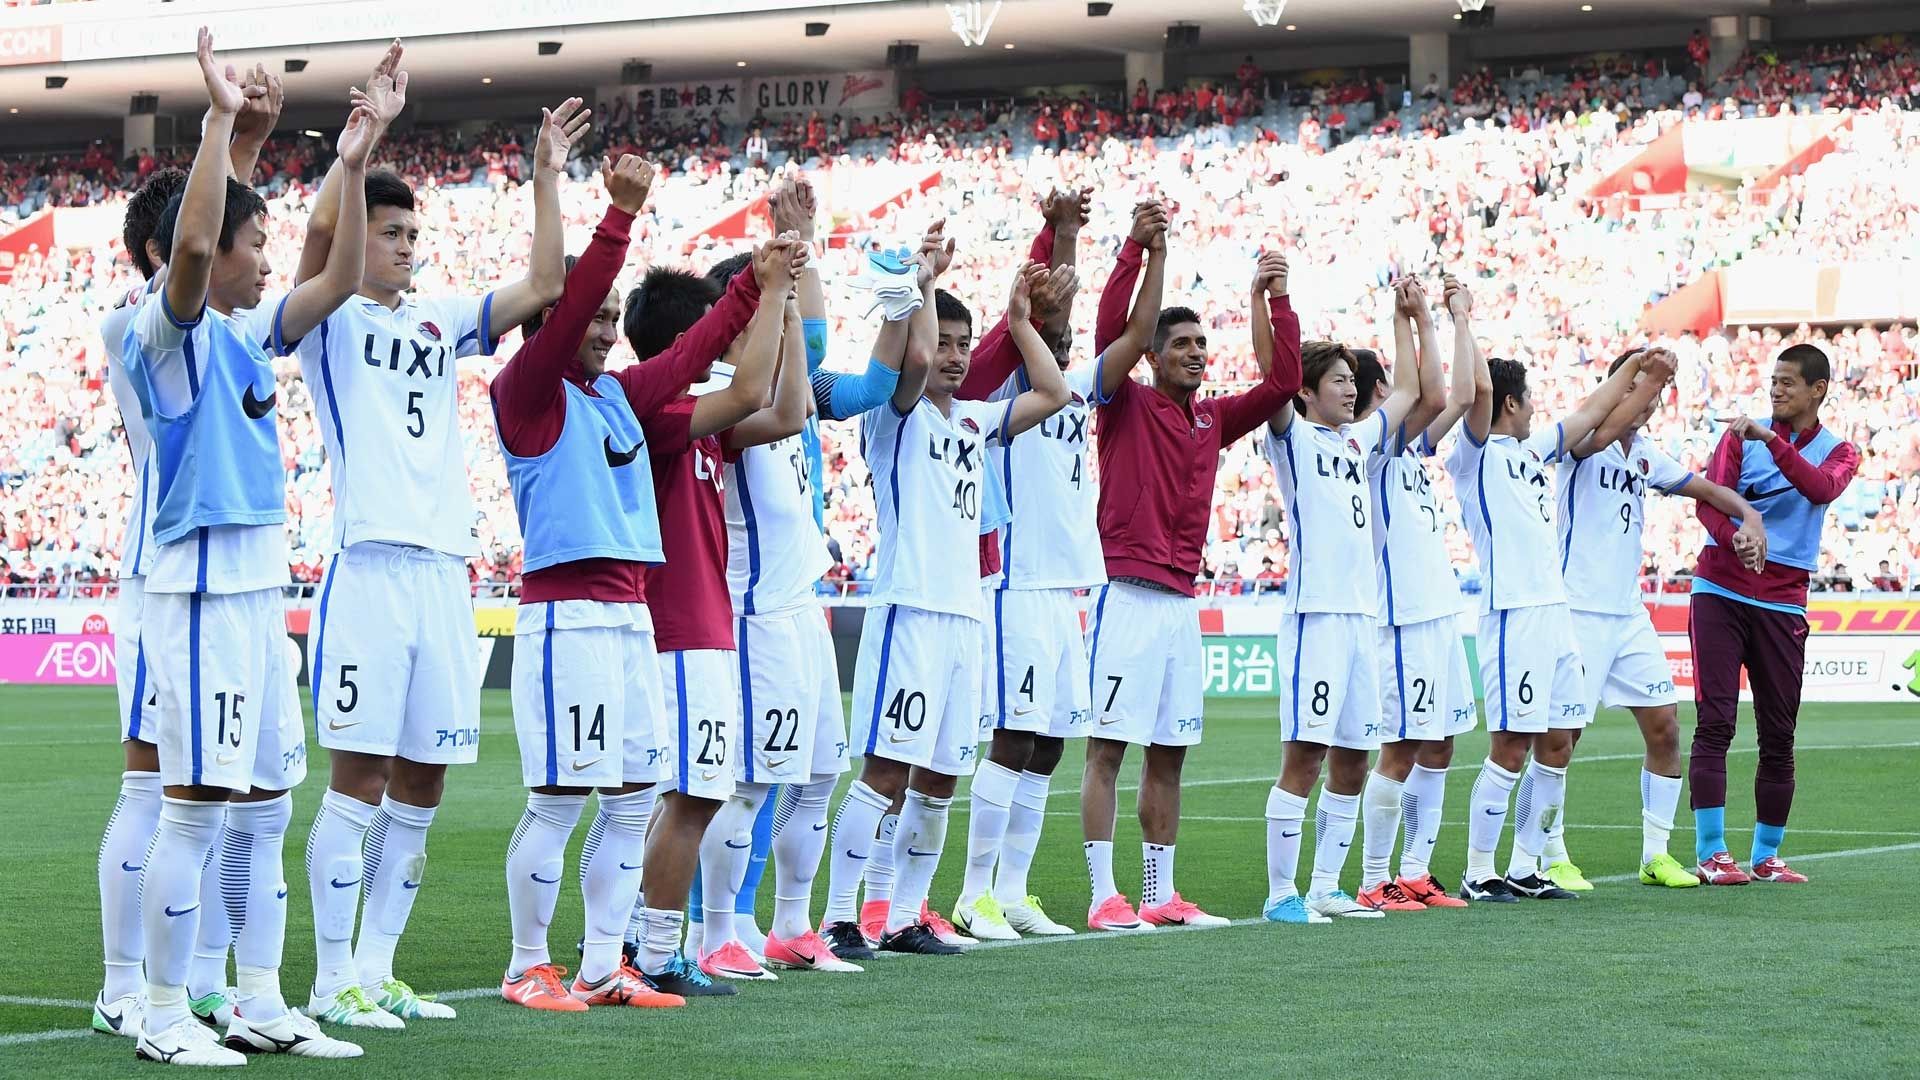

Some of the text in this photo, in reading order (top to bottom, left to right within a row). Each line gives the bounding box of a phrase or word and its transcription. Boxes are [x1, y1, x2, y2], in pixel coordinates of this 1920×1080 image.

[758, 80, 829, 108] GLORY
[364, 333, 452, 379] LIXI
[407, 391, 425, 438] 5
[1071, 454, 1081, 490] 4
[953, 479, 976, 520] 40
[1352, 494, 1366, 528] 8
[1620, 503, 1631, 534] 9
[336, 664, 358, 713] 5
[1019, 665, 1034, 702] 4
[1202, 645, 1275, 692] 明治
[1518, 671, 1533, 704] 6
[885, 687, 926, 732] 40
[1104, 676, 1122, 712] 7
[1311, 681, 1329, 716] 8
[215, 692, 245, 748] 15
[568, 704, 605, 751] 14
[764, 708, 799, 751] 22
[696, 719, 726, 765] 25
